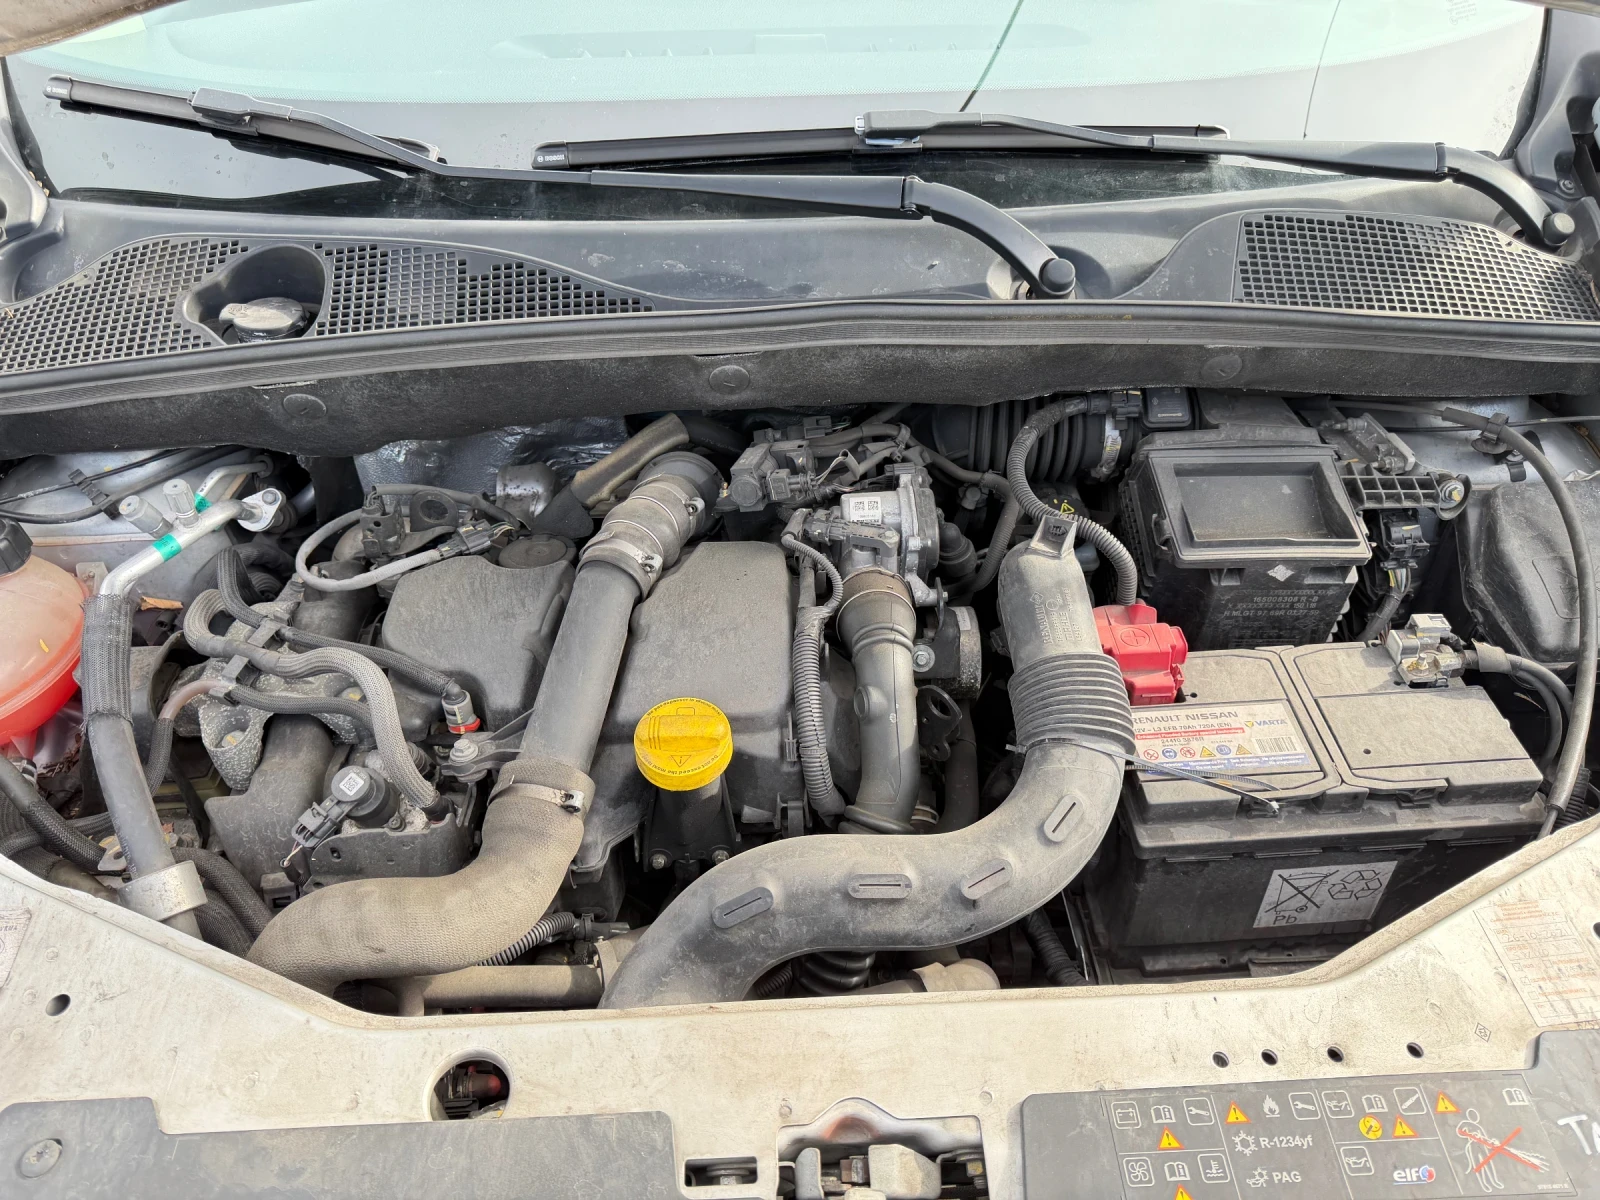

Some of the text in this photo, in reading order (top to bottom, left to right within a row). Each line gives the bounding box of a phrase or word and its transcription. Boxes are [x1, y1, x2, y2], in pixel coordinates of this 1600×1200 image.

[1132, 711, 1239, 724] RENAULT NISSAN
[1273, 915, 1297, 925] Pb
[1259, 1134, 1312, 1149] R-1234yf
[1272, 1171, 1302, 1183] PAG
[1393, 1168, 1419, 1181] elf
